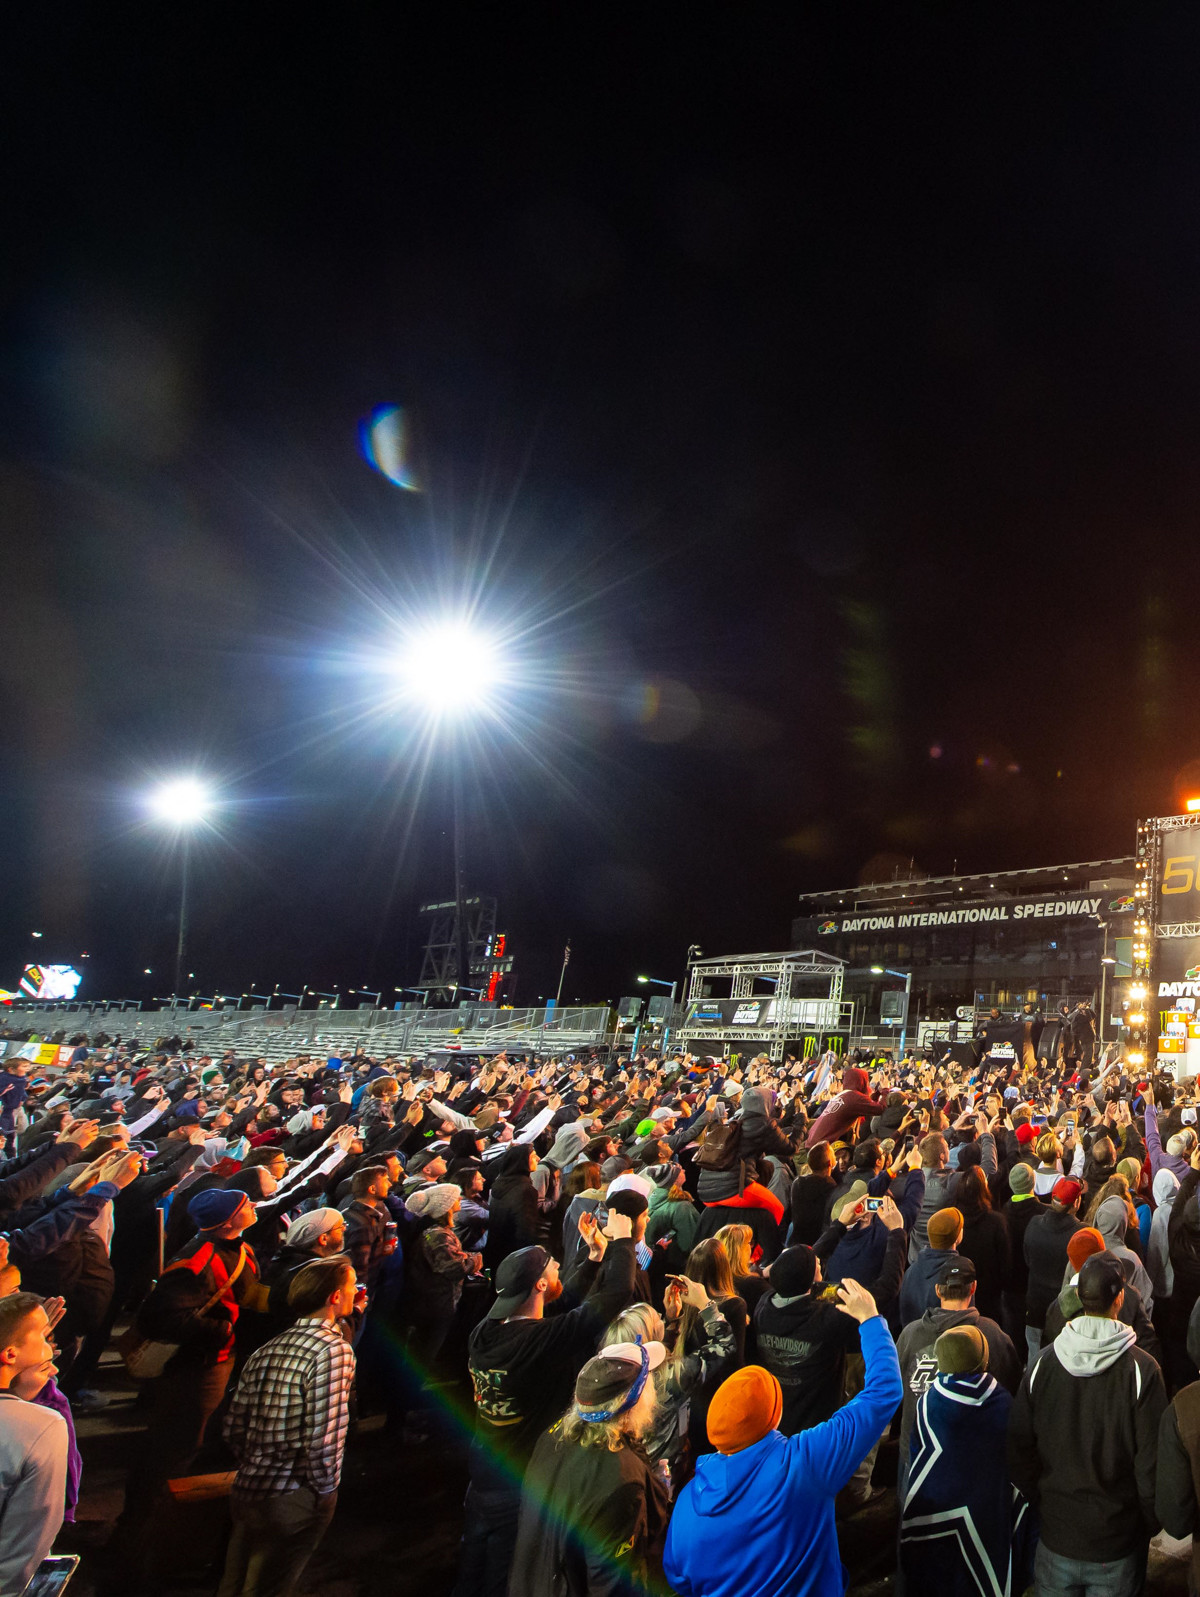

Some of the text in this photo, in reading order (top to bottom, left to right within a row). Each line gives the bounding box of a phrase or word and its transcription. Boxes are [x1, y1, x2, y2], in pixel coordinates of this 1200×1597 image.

[842, 899, 1102, 932] DAYTONA INTERNATIONAL SPEEDWAY
